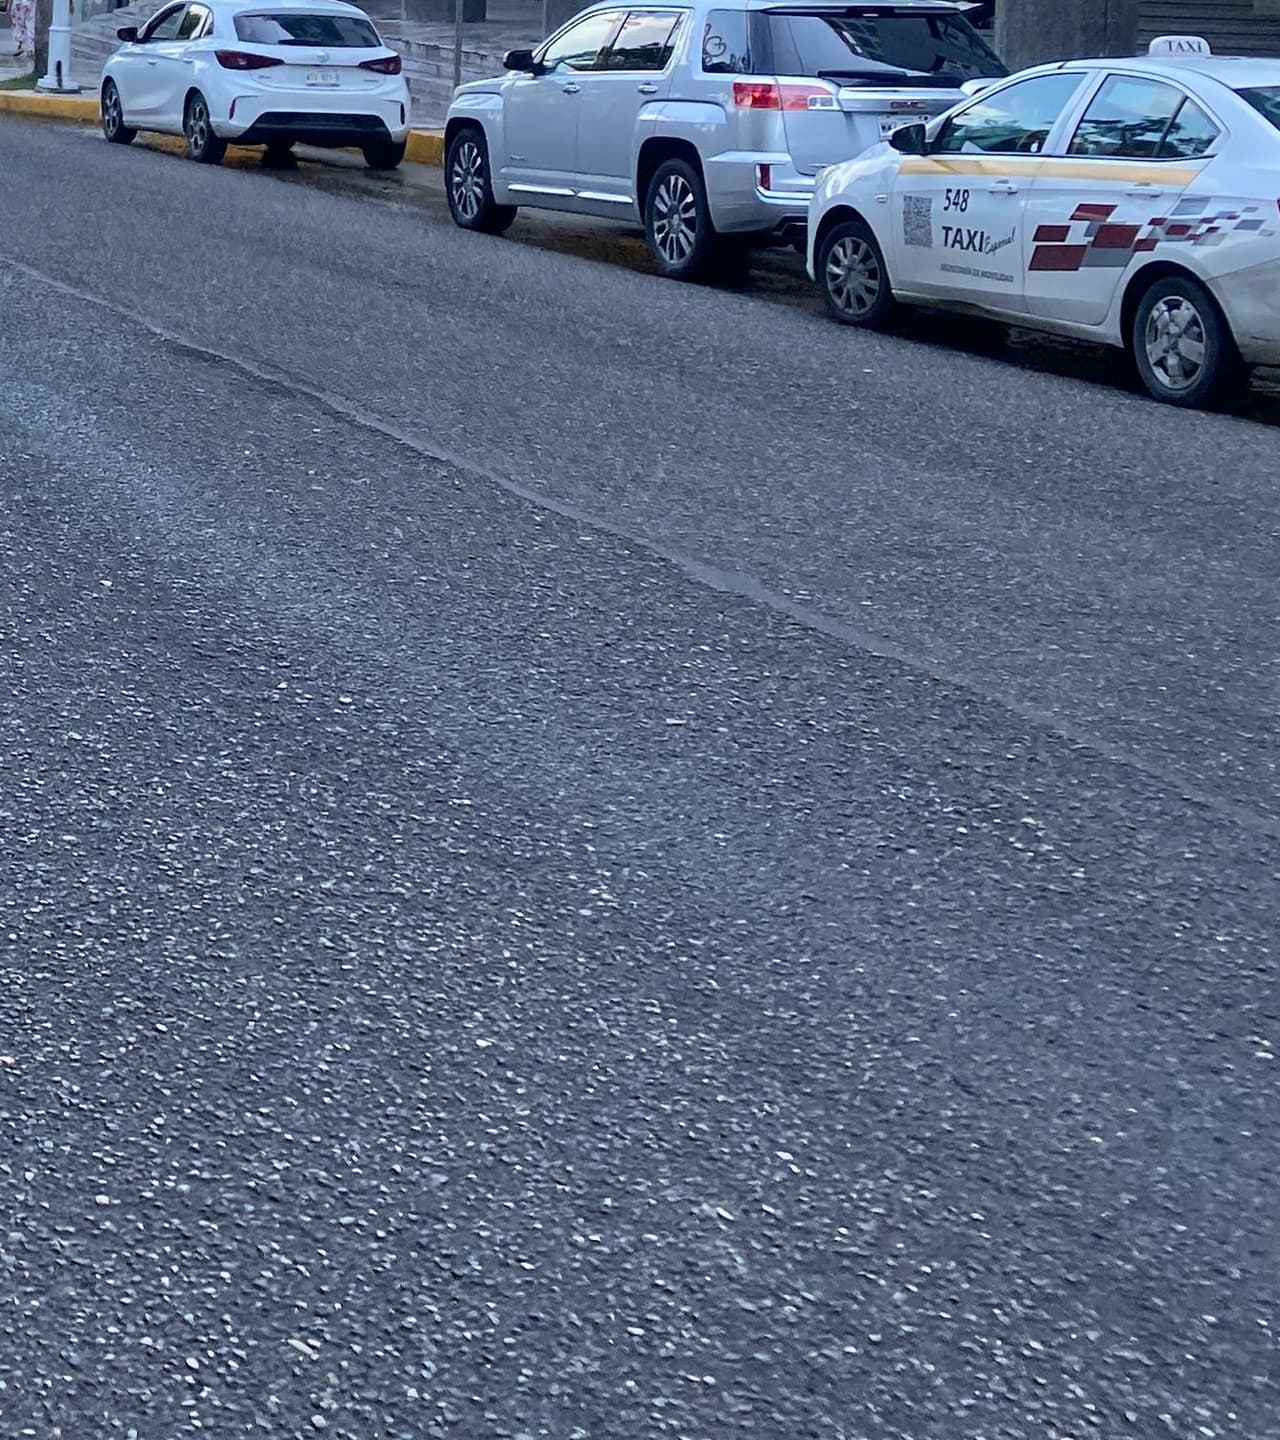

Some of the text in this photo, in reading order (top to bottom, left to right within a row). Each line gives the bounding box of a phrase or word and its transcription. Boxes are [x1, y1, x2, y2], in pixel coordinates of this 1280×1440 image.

[1167, 40, 1202, 53] TAXI
[943, 188, 970, 212] 548
[942, 226, 985, 252] TAXI
